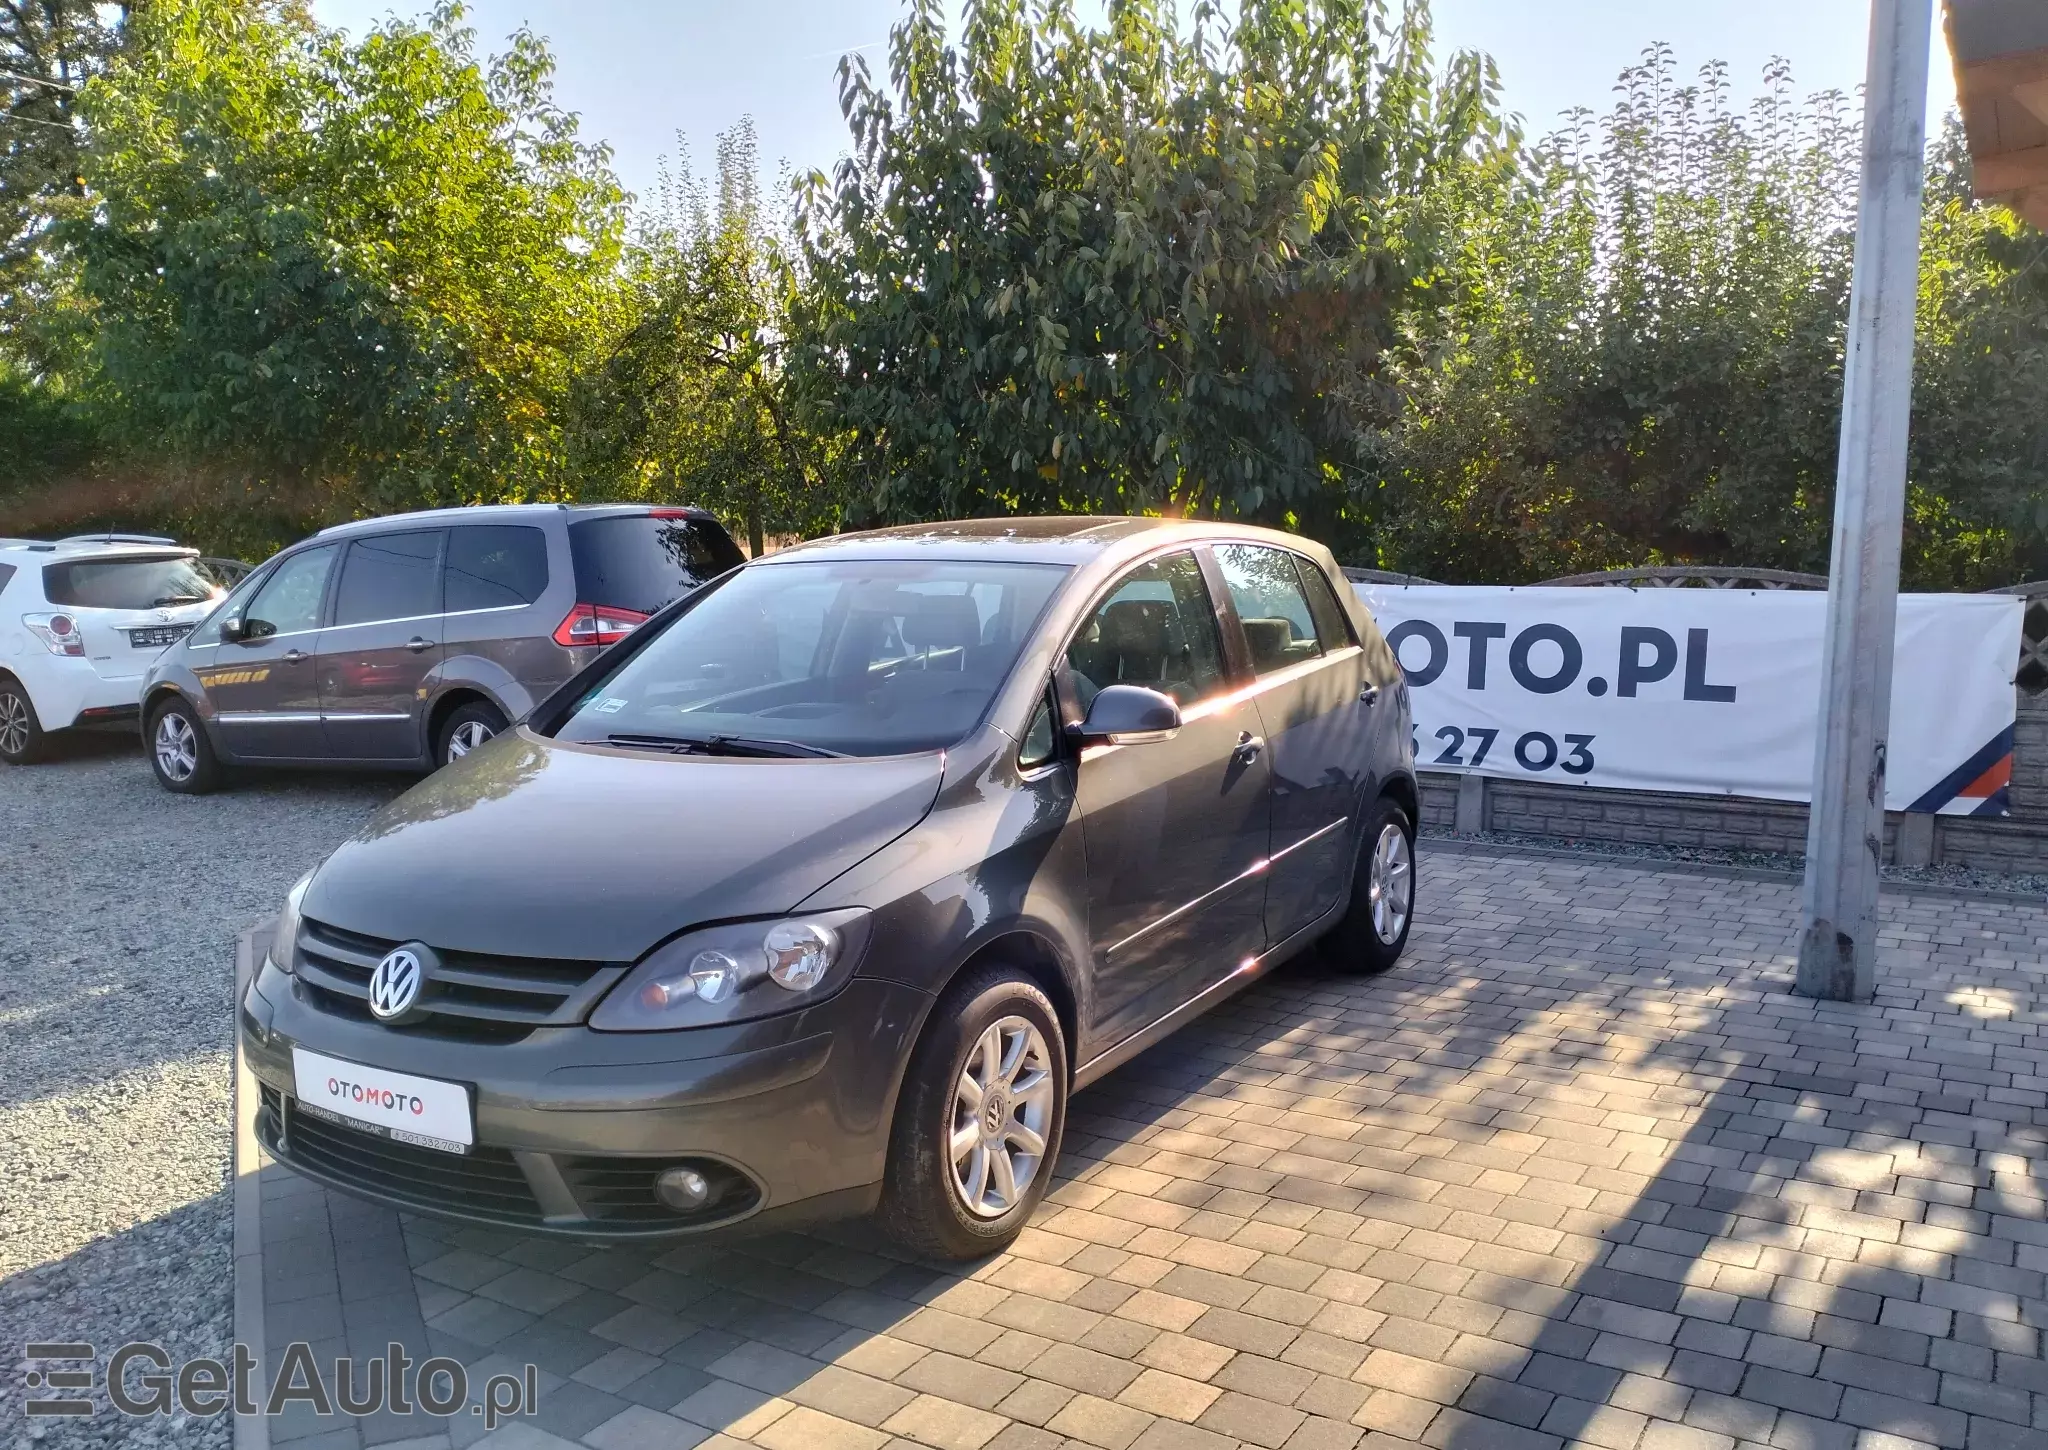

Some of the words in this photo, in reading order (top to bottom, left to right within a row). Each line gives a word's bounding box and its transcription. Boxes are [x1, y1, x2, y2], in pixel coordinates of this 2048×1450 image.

[1374, 617, 1737, 704] OTO.PL
[1433, 725, 1500, 767] 27
[297, 1101, 340, 1123] AUTO-HANDEL
[328, 1077, 424, 1116] OTOMOTO
